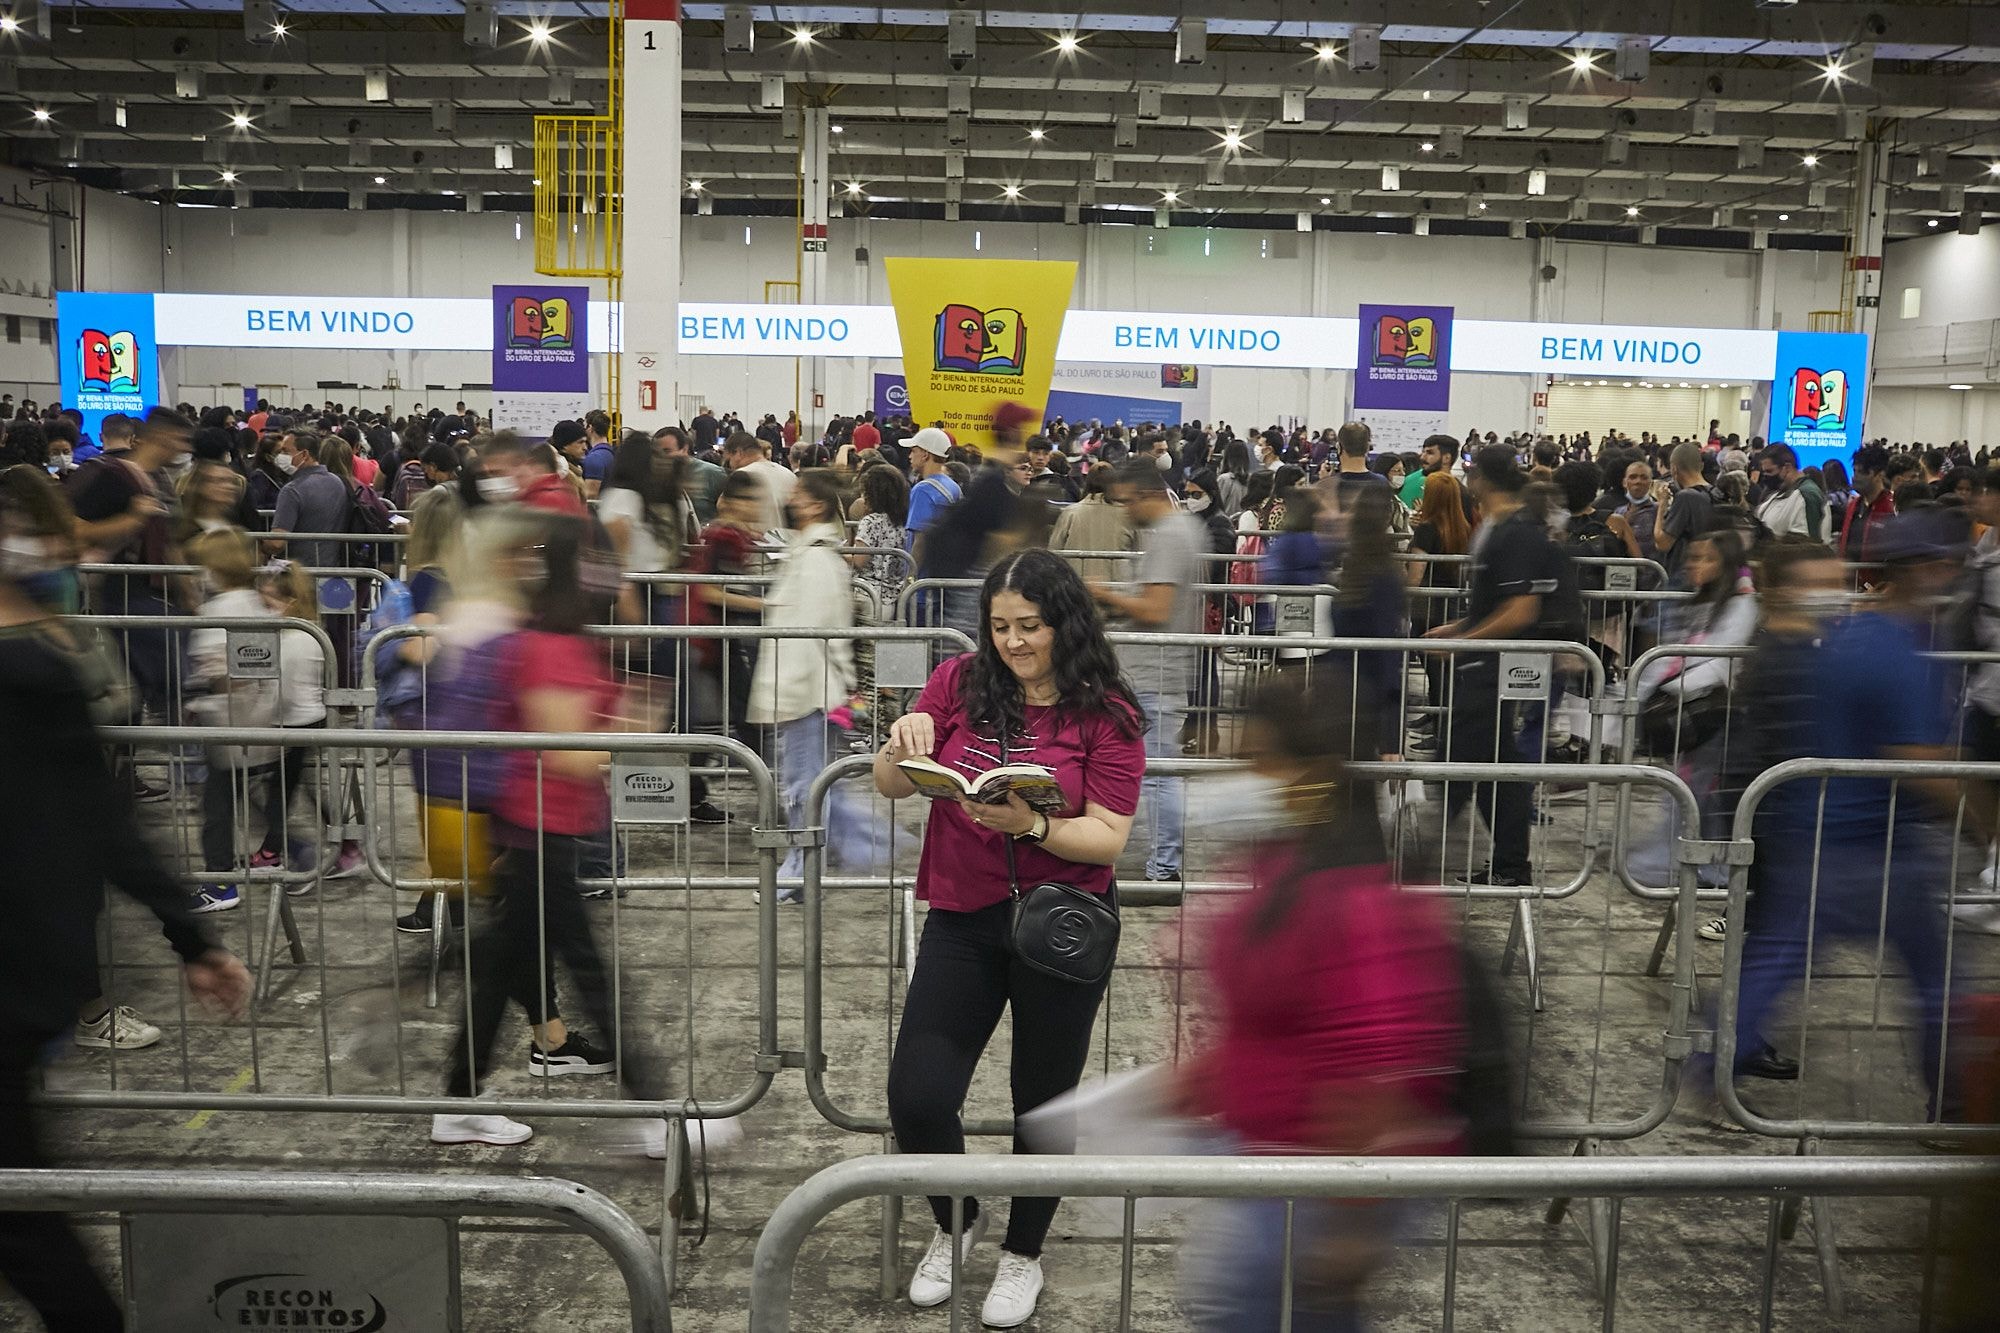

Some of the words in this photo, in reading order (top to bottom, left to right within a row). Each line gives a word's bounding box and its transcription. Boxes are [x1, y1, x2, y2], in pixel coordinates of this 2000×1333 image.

[644, 31, 657, 50] 1
[247, 309, 311, 332] BEM
[321, 310, 414, 334] VINDO
[681, 316, 745, 340] BEM
[755, 317, 849, 342] VINDO
[1115, 325, 1179, 349] BEM
[1188, 327, 1281, 352] VINDO
[1541, 336, 1603, 362] BEM
[1613, 339, 1702, 365] VINDO
[555, 355, 575, 363] PAULO
[969, 376, 1026, 386] INTERNACIONAL
[1067, 369, 1078, 378] DO
[1080, 370, 1101, 378] LIVRO
[1103, 370, 1113, 378] DE
[1115, 368, 1131, 379] SÃO
[1132, 370, 1157, 380] PAULO
[930, 382, 943, 391] DO
[943, 383, 967, 392] LIVRO
[968, 384, 979, 393] DE
[980, 385, 997, 394] SÃO
[998, 386, 1024, 396] PAULO
[78, 402, 86, 410] DO
[87, 402, 104, 410] LIVRO
[104, 402, 112, 410] DE
[125, 403, 143, 411] PAULO
[943, 410, 962, 420] Todo
[965, 411, 994, 421] mundo
[961, 421, 971, 430] do
[974, 423, 989, 431] que
[246, 1289, 334, 1307] RECON
[238, 1308, 365, 1327] EVENTOS
